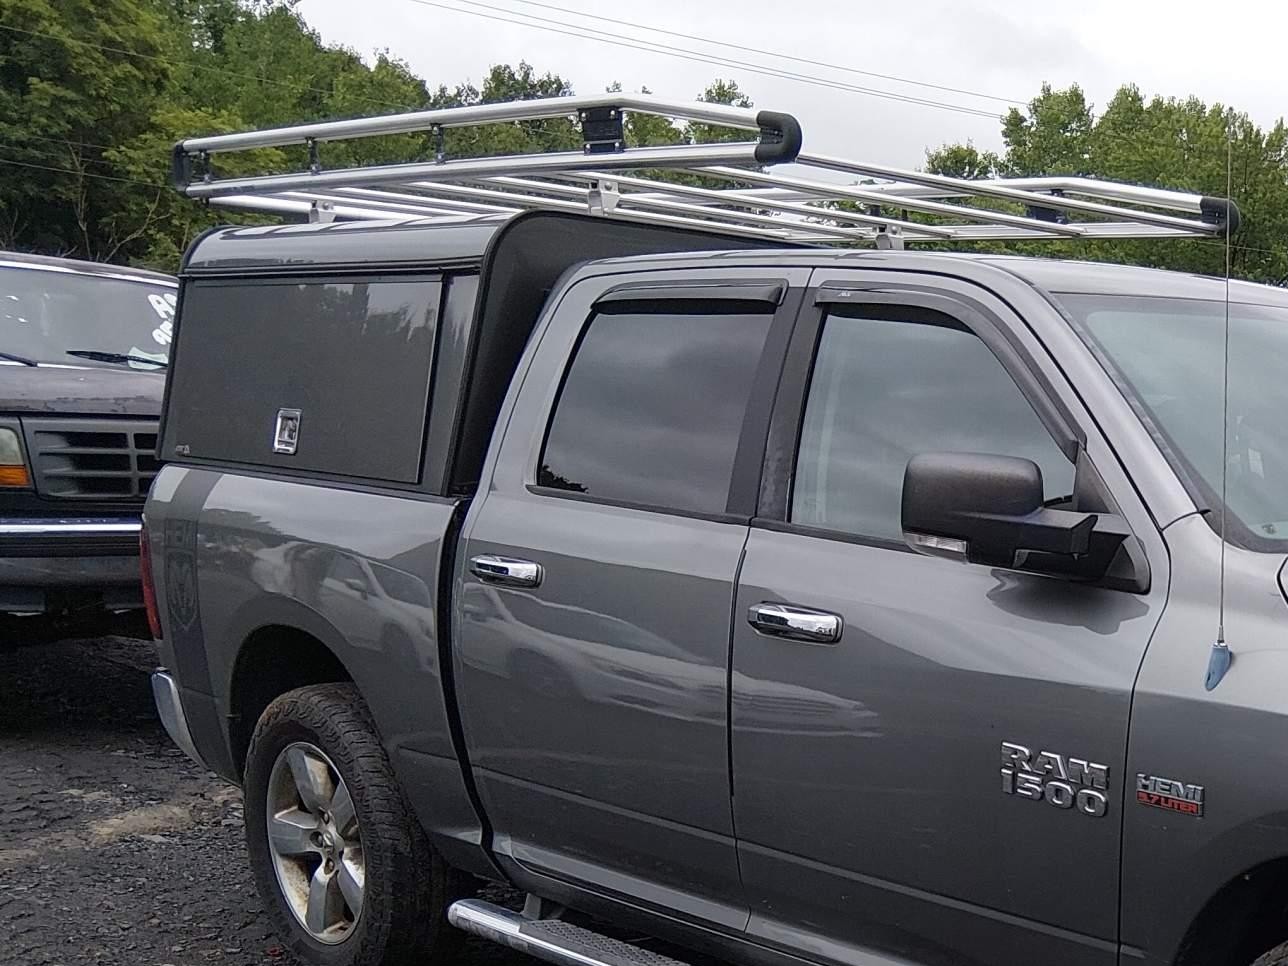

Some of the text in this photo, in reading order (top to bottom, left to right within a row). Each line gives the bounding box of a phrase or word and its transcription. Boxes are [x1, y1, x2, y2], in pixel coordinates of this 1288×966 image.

[1001, 742, 1109, 791] RAM
[1001, 768, 1108, 817] 1500
[1137, 773, 1204, 803] HEMI
[1160, 797, 1198, 814] LITER
